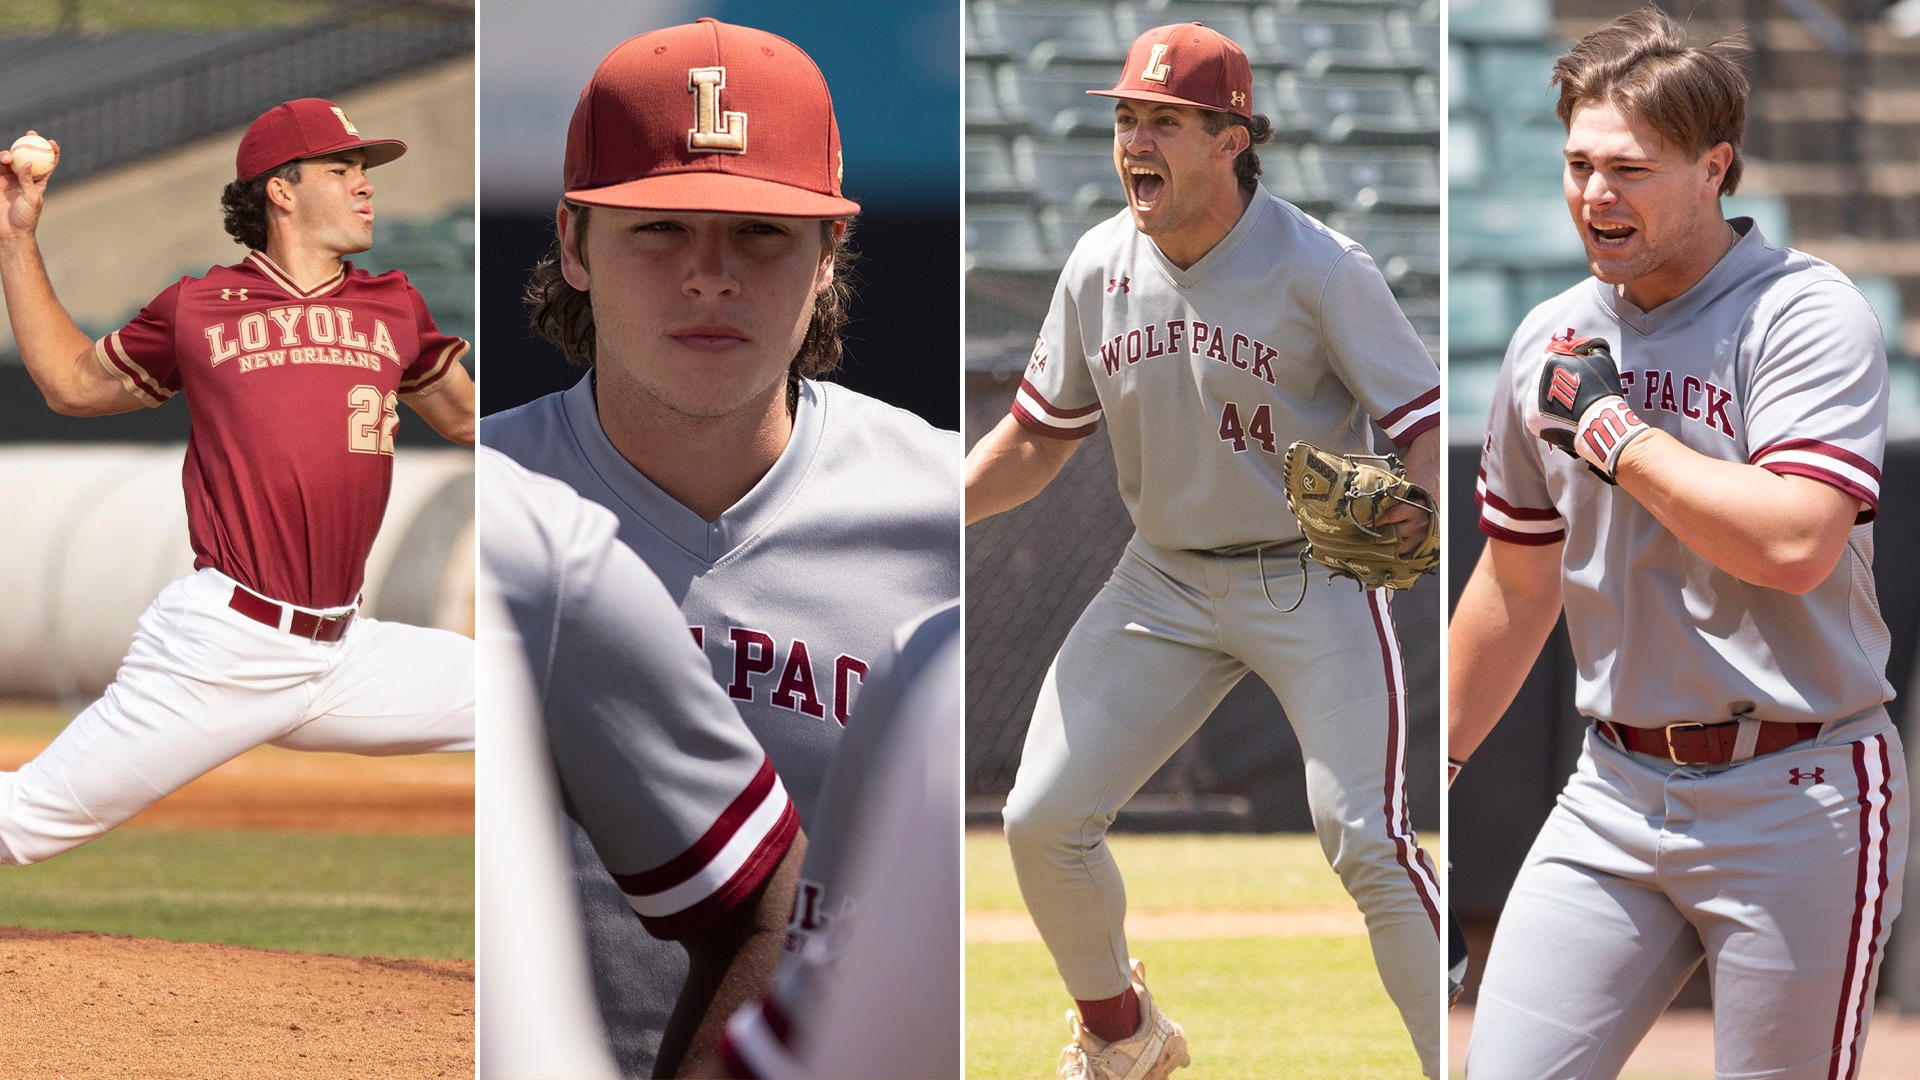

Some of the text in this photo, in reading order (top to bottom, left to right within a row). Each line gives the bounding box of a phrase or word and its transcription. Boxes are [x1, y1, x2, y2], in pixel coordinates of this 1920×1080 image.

[1140, 43, 1171, 85] L
[687, 66, 748, 155] L
[204, 304, 400, 367] LOYOLA
[238, 347, 382, 374] NEW ORLEANS
[1218, 402, 1278, 455] 44
[1643, 369, 1735, 440] PACK
